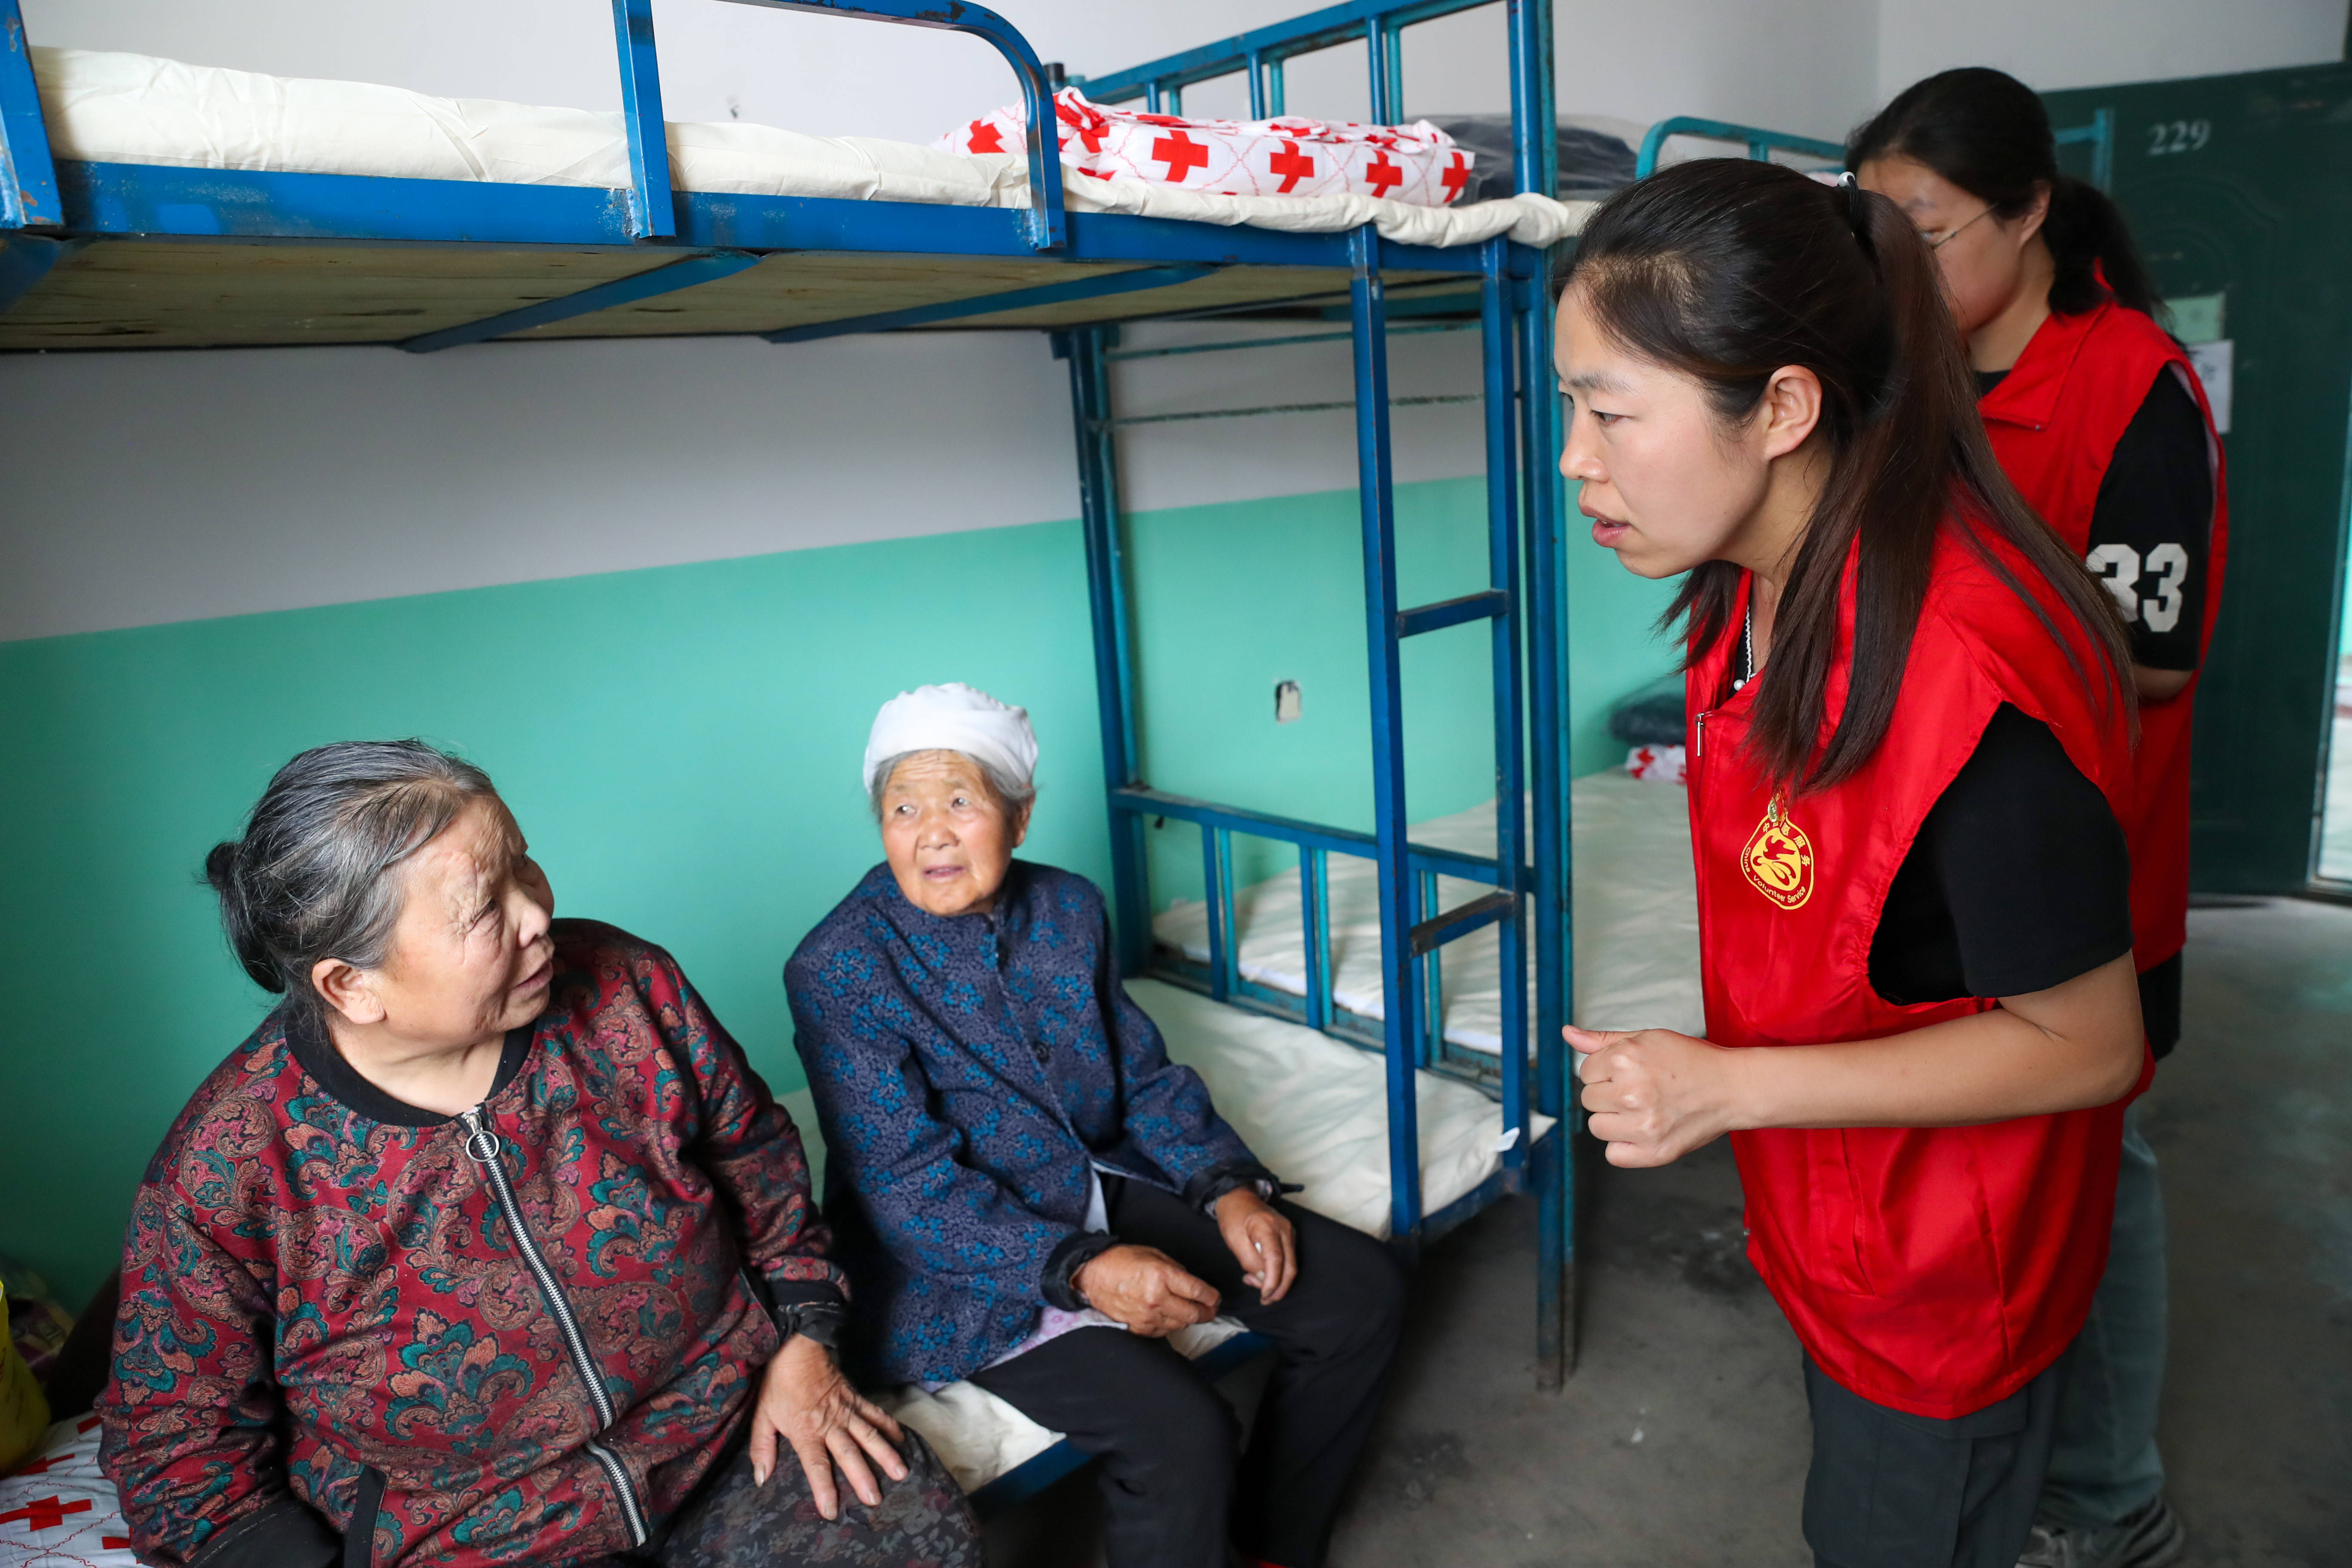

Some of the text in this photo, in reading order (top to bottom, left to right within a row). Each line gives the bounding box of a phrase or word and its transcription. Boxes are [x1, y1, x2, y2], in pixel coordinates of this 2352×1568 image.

[2148, 119, 2211, 156] 229
[2086, 543, 2188, 632] 33
[1763, 821, 1810, 867] 中愿服务
[1754, 875, 1785, 902] Volunteer
[1787, 886, 1806, 903] Service
